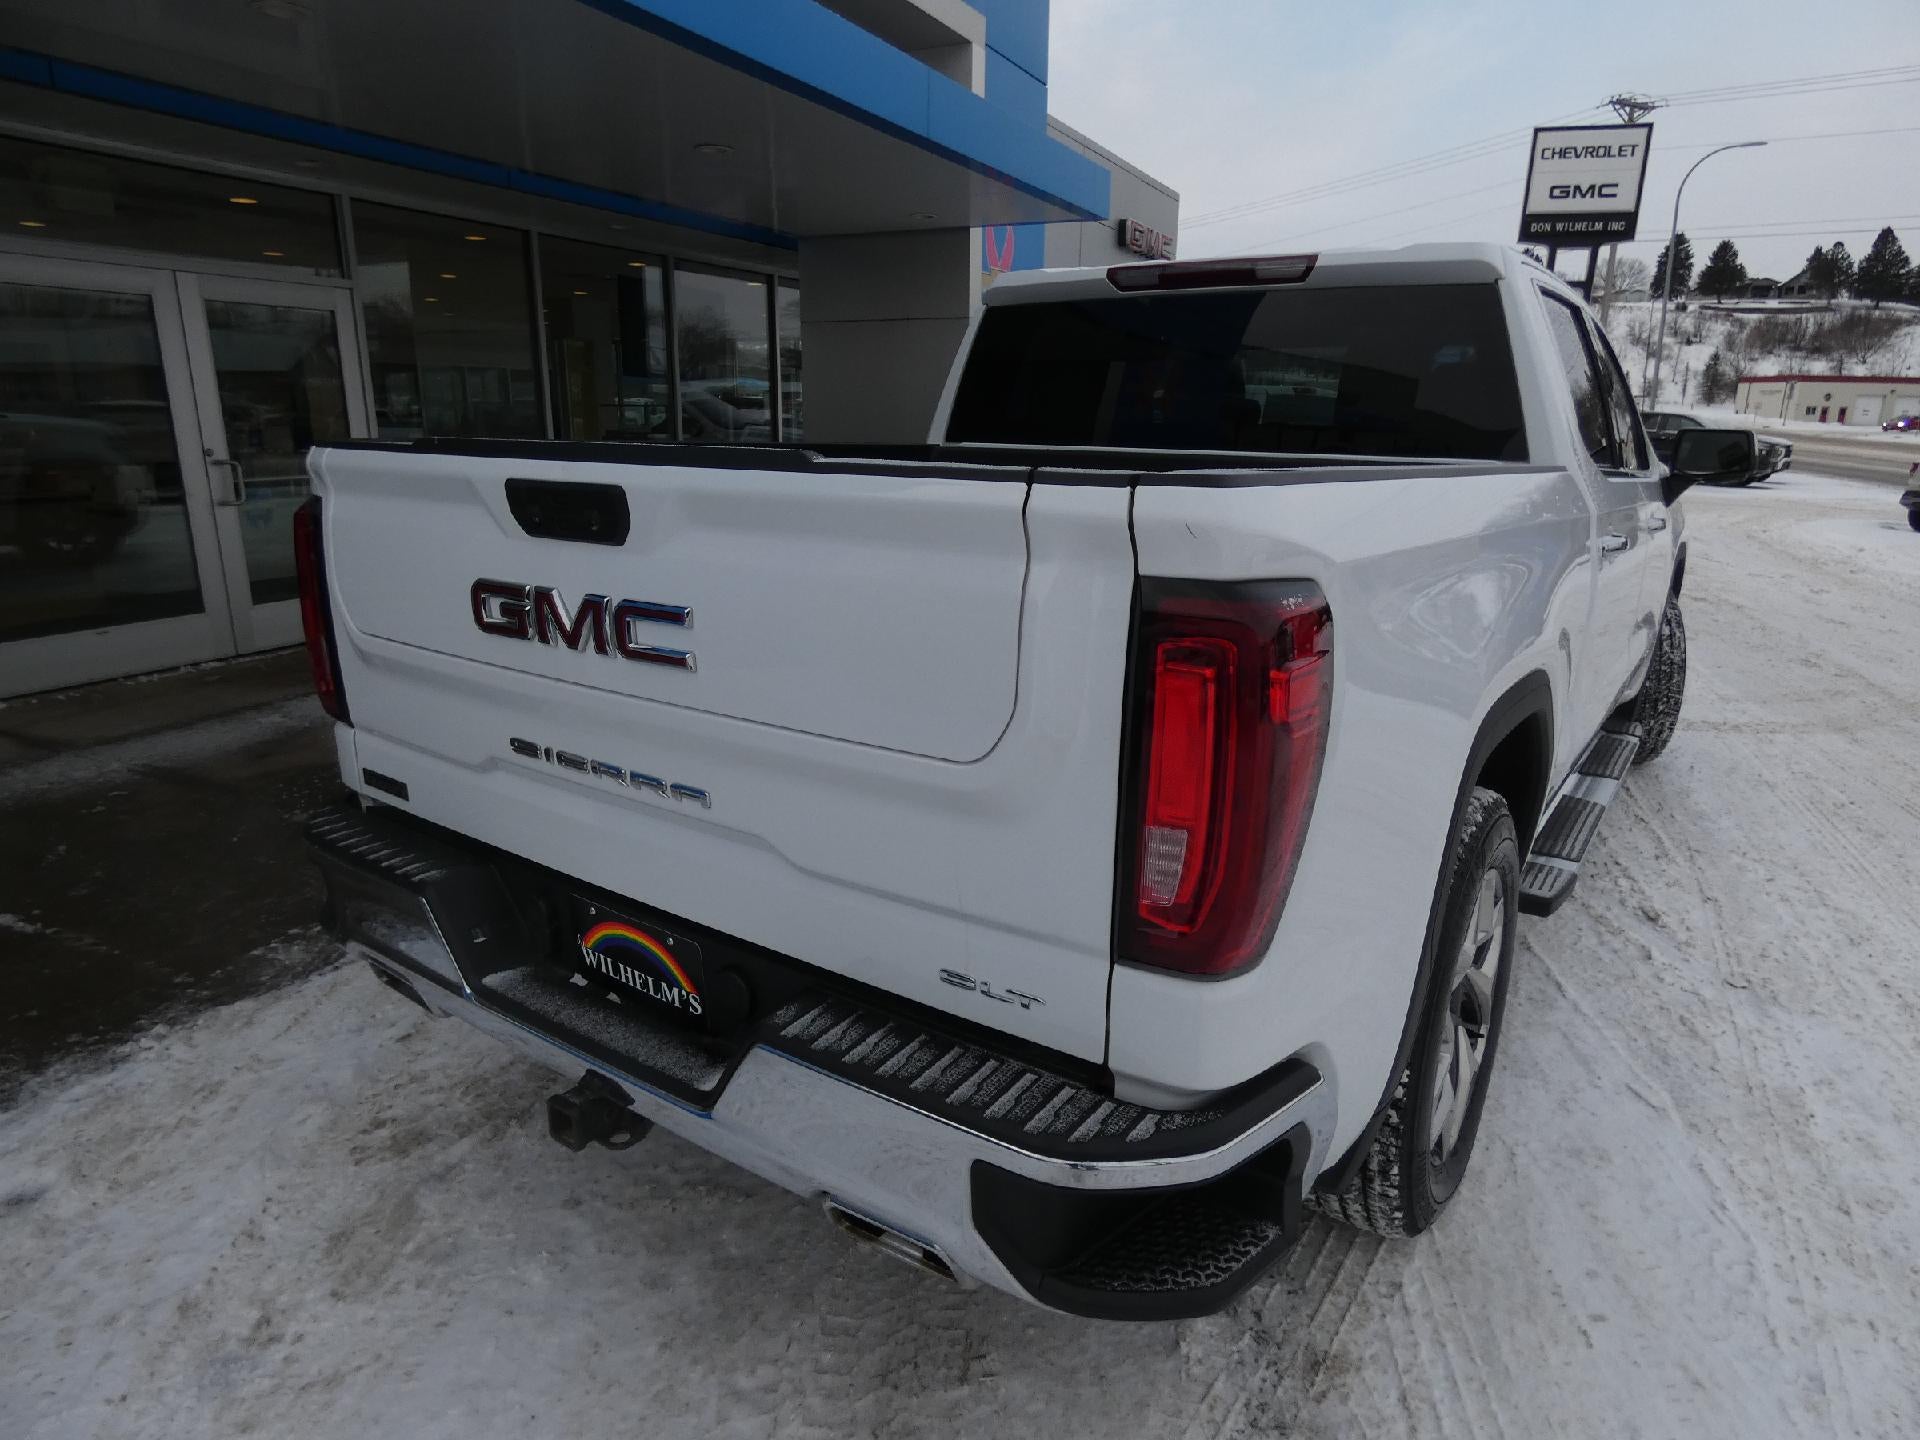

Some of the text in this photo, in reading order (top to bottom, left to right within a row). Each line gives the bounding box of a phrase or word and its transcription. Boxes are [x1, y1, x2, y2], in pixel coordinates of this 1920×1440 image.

[1540, 144, 1639, 160] CHEVROLET
[1549, 183, 1619, 199] GMC
[1126, 218, 1175, 260] GMC
[1530, 221, 1626, 233] DON WILHELM INC
[471, 577, 698, 673] GMC
[509, 737, 712, 809] SIERRA
[581, 941, 702, 1015] WILHELM'S
[939, 968, 1046, 1010] SLT
